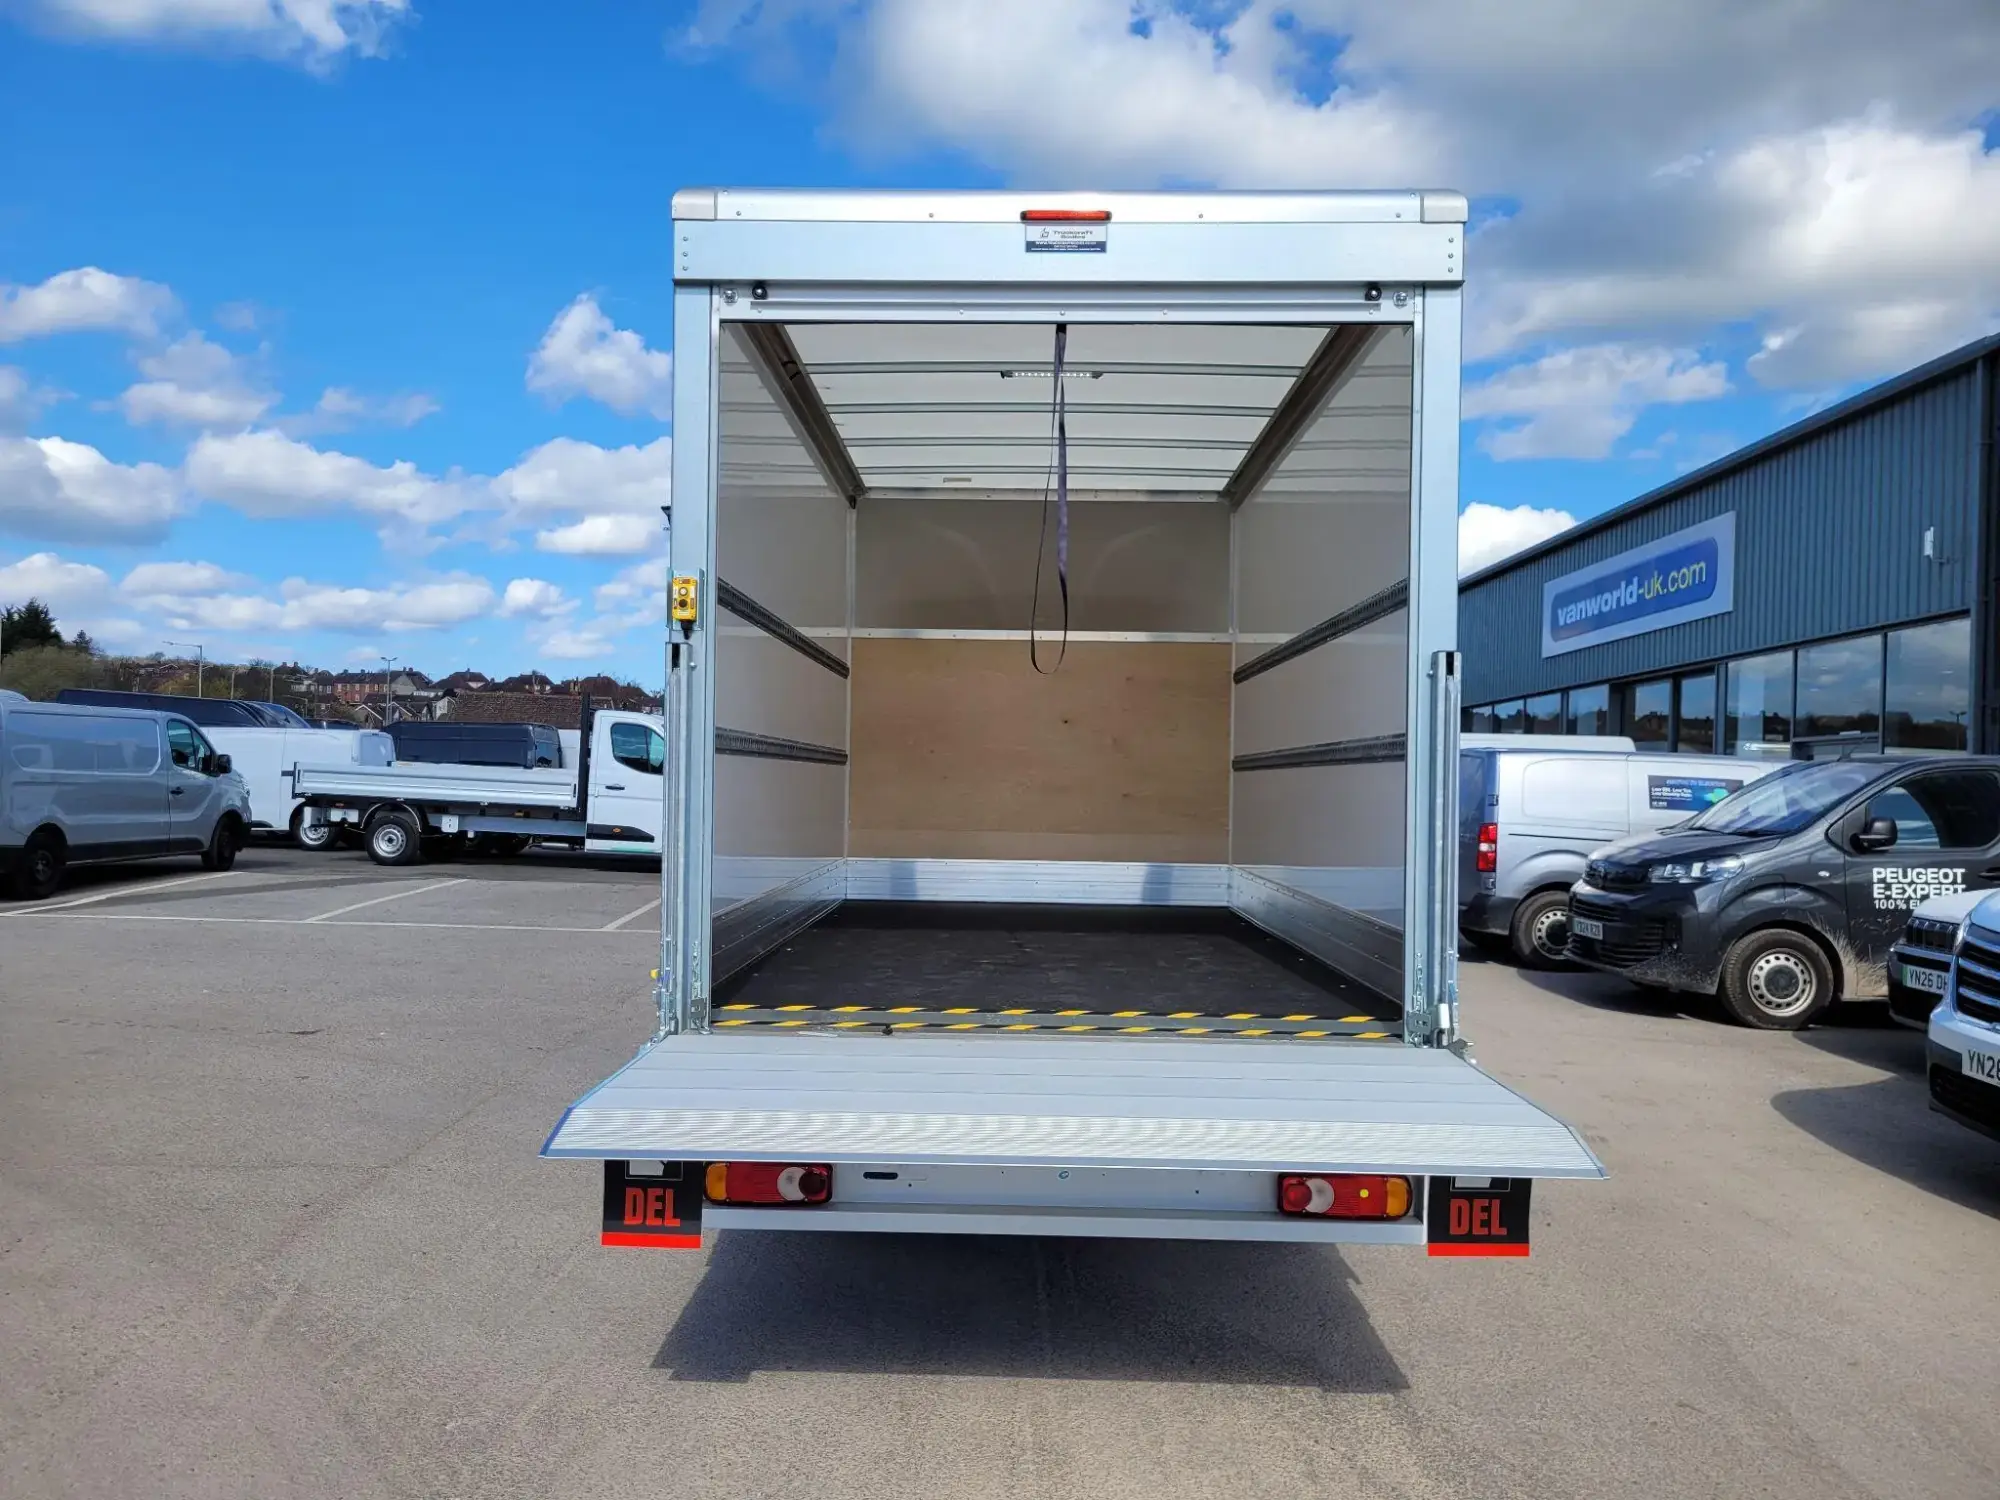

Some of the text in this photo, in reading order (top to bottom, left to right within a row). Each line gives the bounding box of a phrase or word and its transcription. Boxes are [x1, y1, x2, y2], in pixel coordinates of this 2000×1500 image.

[1557, 561, 1706, 626] vanworld-uk.com
[1872, 867, 1966, 883] PEUGEOT
[1873, 884, 1967, 899] E-EXPERT
[1874, 899, 1906, 910] 100%
[1908, 967, 1934, 988] YN26
[624, 1187, 681, 1227] DEL
[1449, 1199, 1508, 1236] DEL
